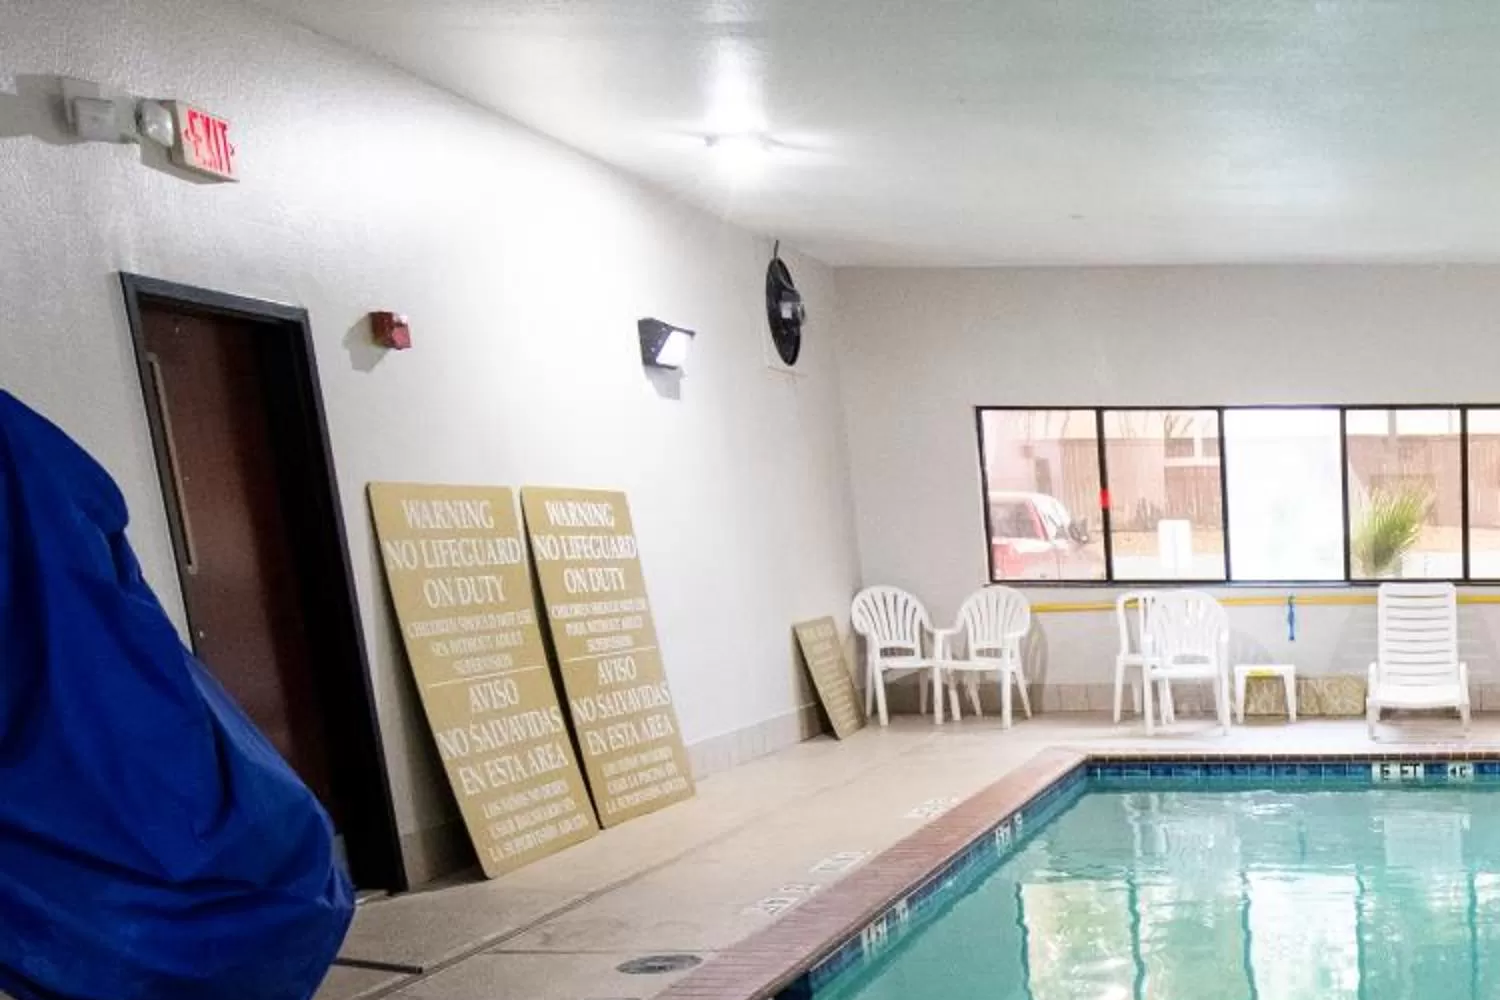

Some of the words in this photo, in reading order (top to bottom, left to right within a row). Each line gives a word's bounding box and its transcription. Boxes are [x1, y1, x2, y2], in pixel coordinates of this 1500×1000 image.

[187, 108, 232, 175] EXIT
[401, 500, 494, 529] WARNING
[544, 501, 615, 527] WARNING
[383, 540, 418, 570] NO
[421, 537, 521, 568] LIFEGUARD
[533, 535, 560, 560] NO
[563, 535, 637, 560] LIFEGUARD
[423, 577, 453, 608] ON
[458, 576, 507, 604] DUTY
[564, 568, 589, 593] ON
[589, 567, 626, 592] DUTY
[598, 656, 637, 685] AVISO
[468, 679, 520, 714] AVISO
[571, 697, 597, 726] NO
[596, 682, 672, 719] SALVAVIDAS
[435, 727, 470, 760] NO
[470, 706, 565, 753] SALVAVIDAS
[584, 730, 608, 755] EN
[607, 721, 640, 751] ESTA
[640, 714, 675, 741] AREA
[459, 765, 488, 796] EN
[484, 753, 528, 788] ESTA
[526, 742, 569, 776] AREA
